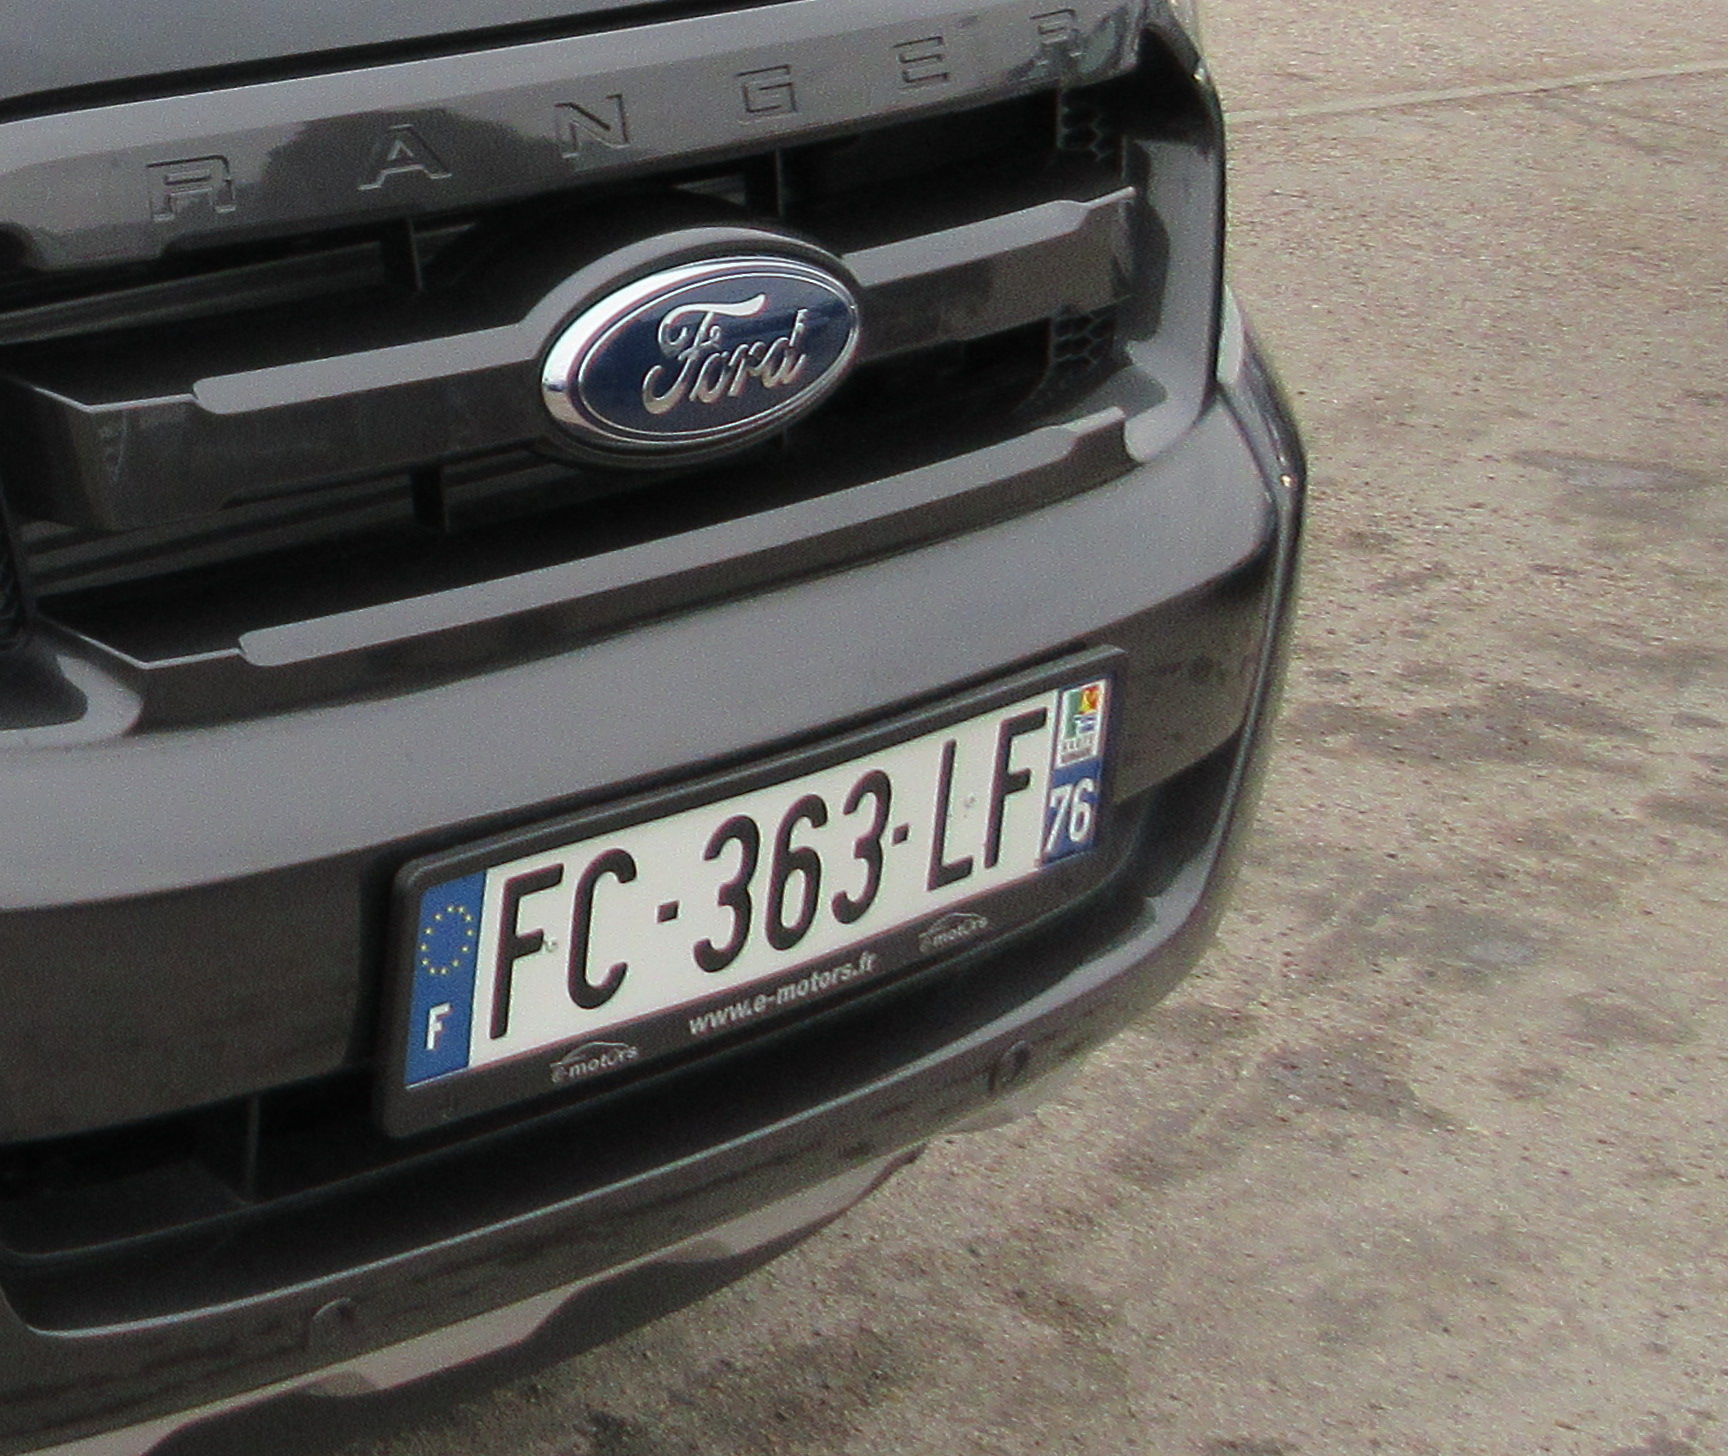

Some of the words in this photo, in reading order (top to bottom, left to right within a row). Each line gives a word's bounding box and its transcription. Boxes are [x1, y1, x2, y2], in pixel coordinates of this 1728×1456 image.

[147, 7, 1084, 223] RANGER
[642, 293, 809, 415] Ford
[1044, 778, 1095, 852] 76
[488, 706, 1048, 1041] FC-363-LF
[425, 1002, 451, 1051] F
[689, 950, 878, 1034] www.e-motors.fr
